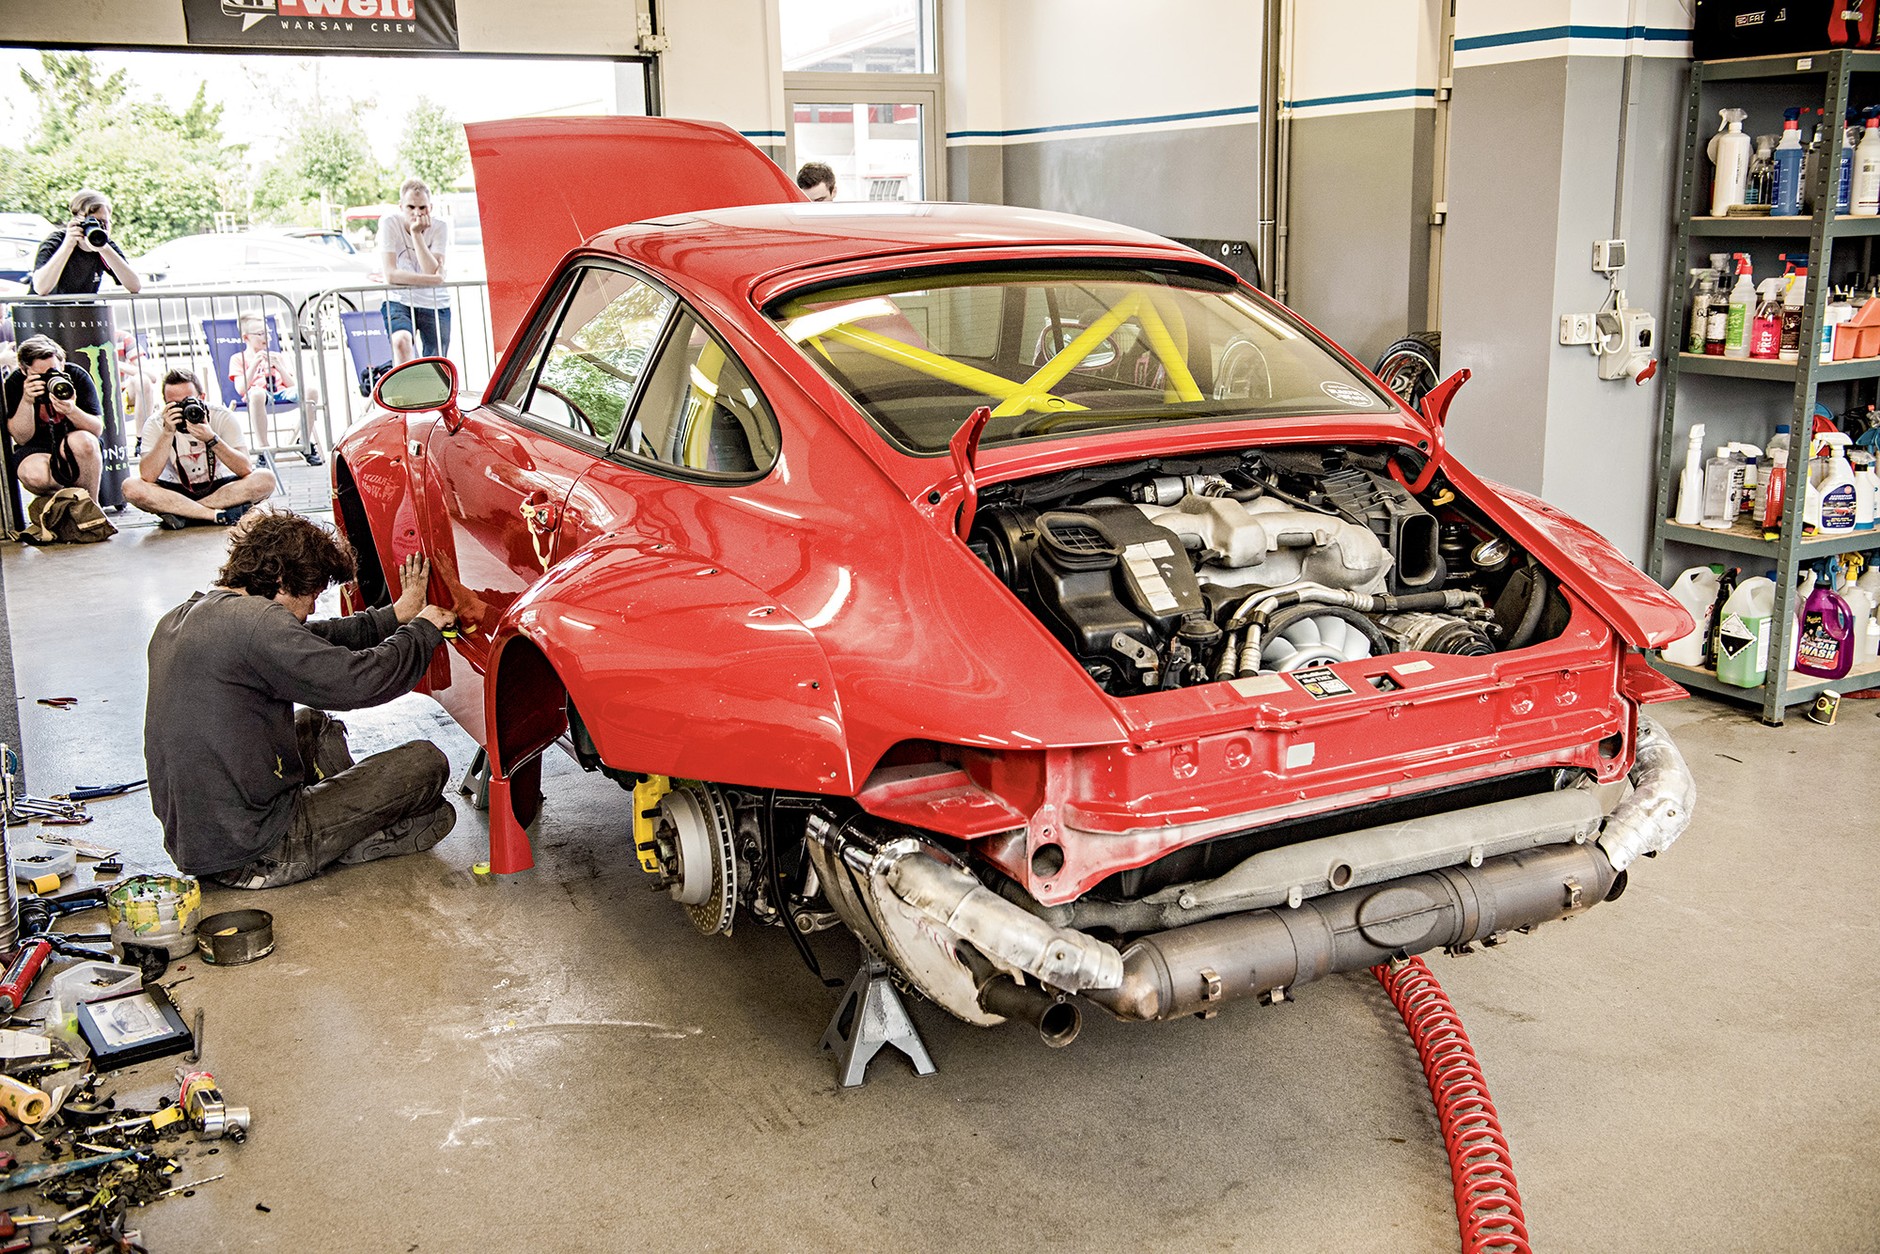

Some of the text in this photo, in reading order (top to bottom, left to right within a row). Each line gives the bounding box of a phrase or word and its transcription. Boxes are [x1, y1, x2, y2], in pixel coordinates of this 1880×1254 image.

[281, 21, 415, 33] WARSAW CREW
[1760, 331, 1773, 353] PREP
[1800, 645, 1836, 660] WASH
[1816, 642, 1836, 650] CAR
